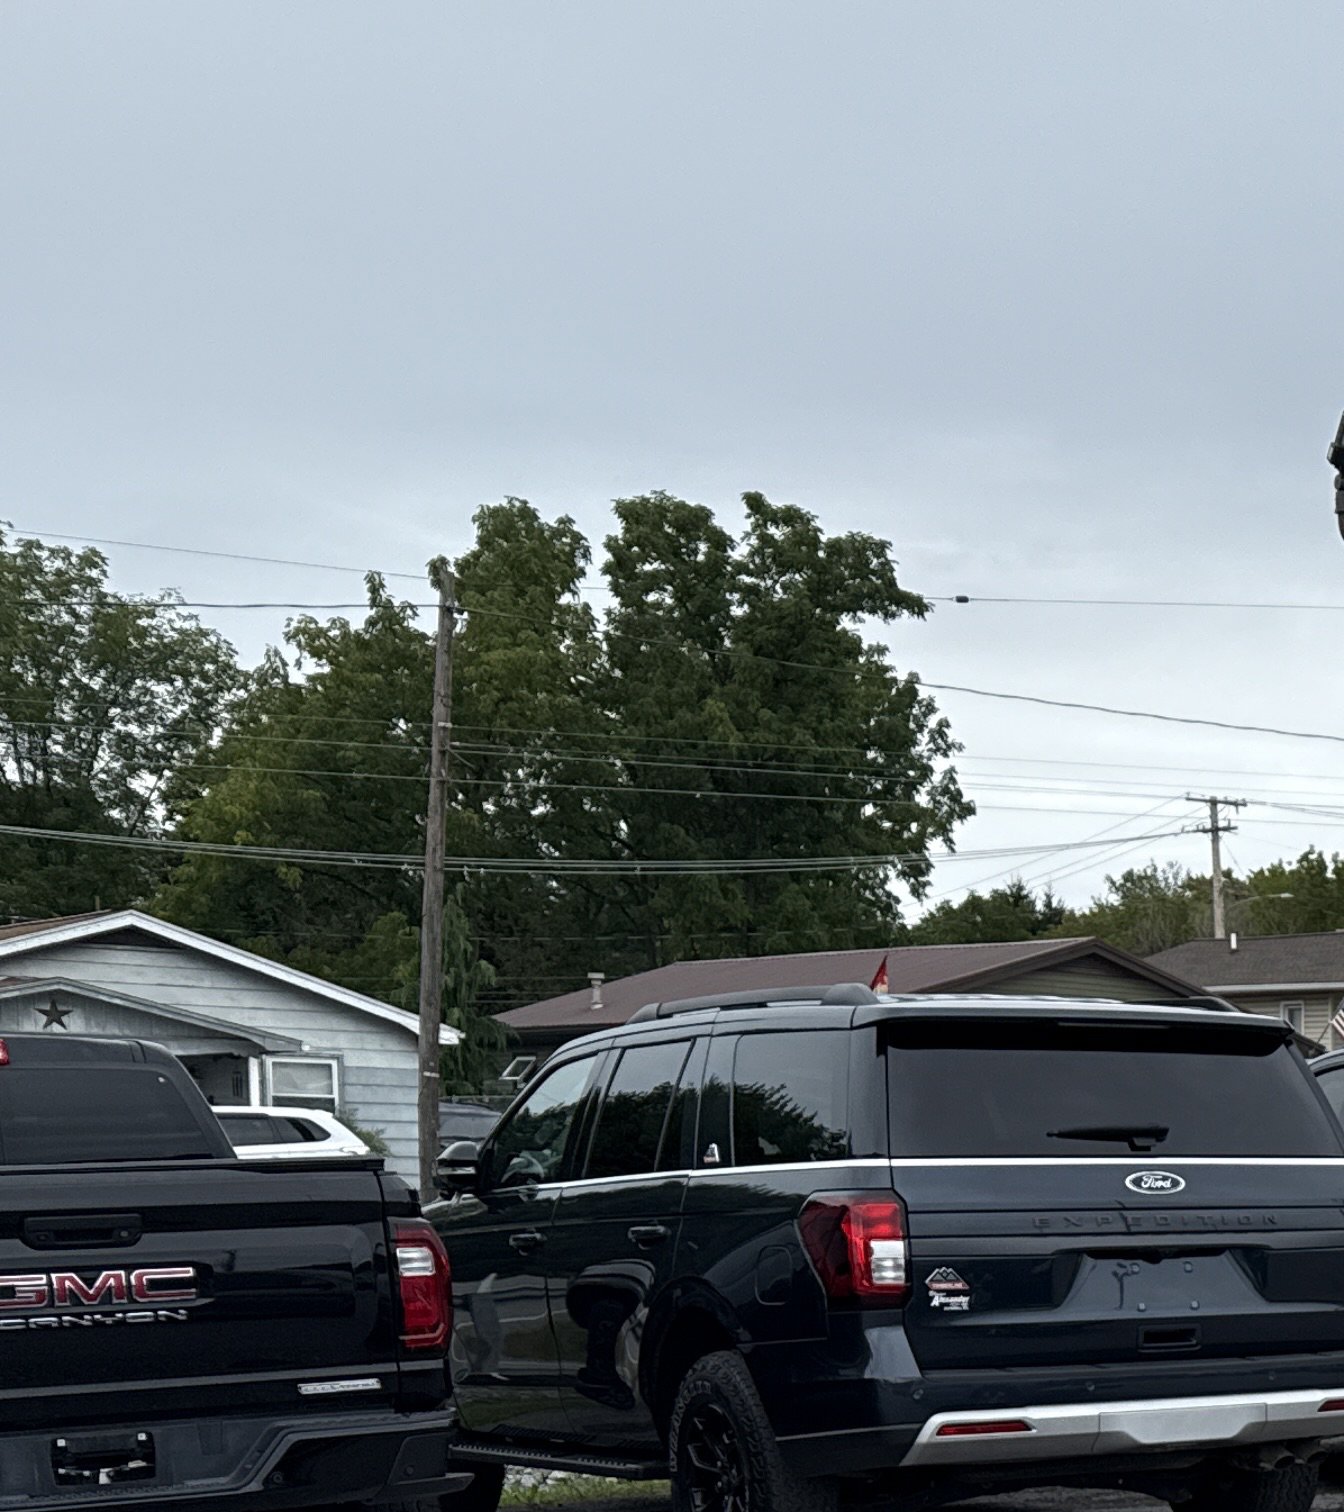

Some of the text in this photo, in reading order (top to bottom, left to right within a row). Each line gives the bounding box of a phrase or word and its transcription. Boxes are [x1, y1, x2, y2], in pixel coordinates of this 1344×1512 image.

[1141, 1175, 1172, 1188] Ford
[1033, 1213, 1278, 1229] EXPEDITION
[0, 1267, 197, 1310] GMC
[0, 1309, 188, 1330] CANYON
